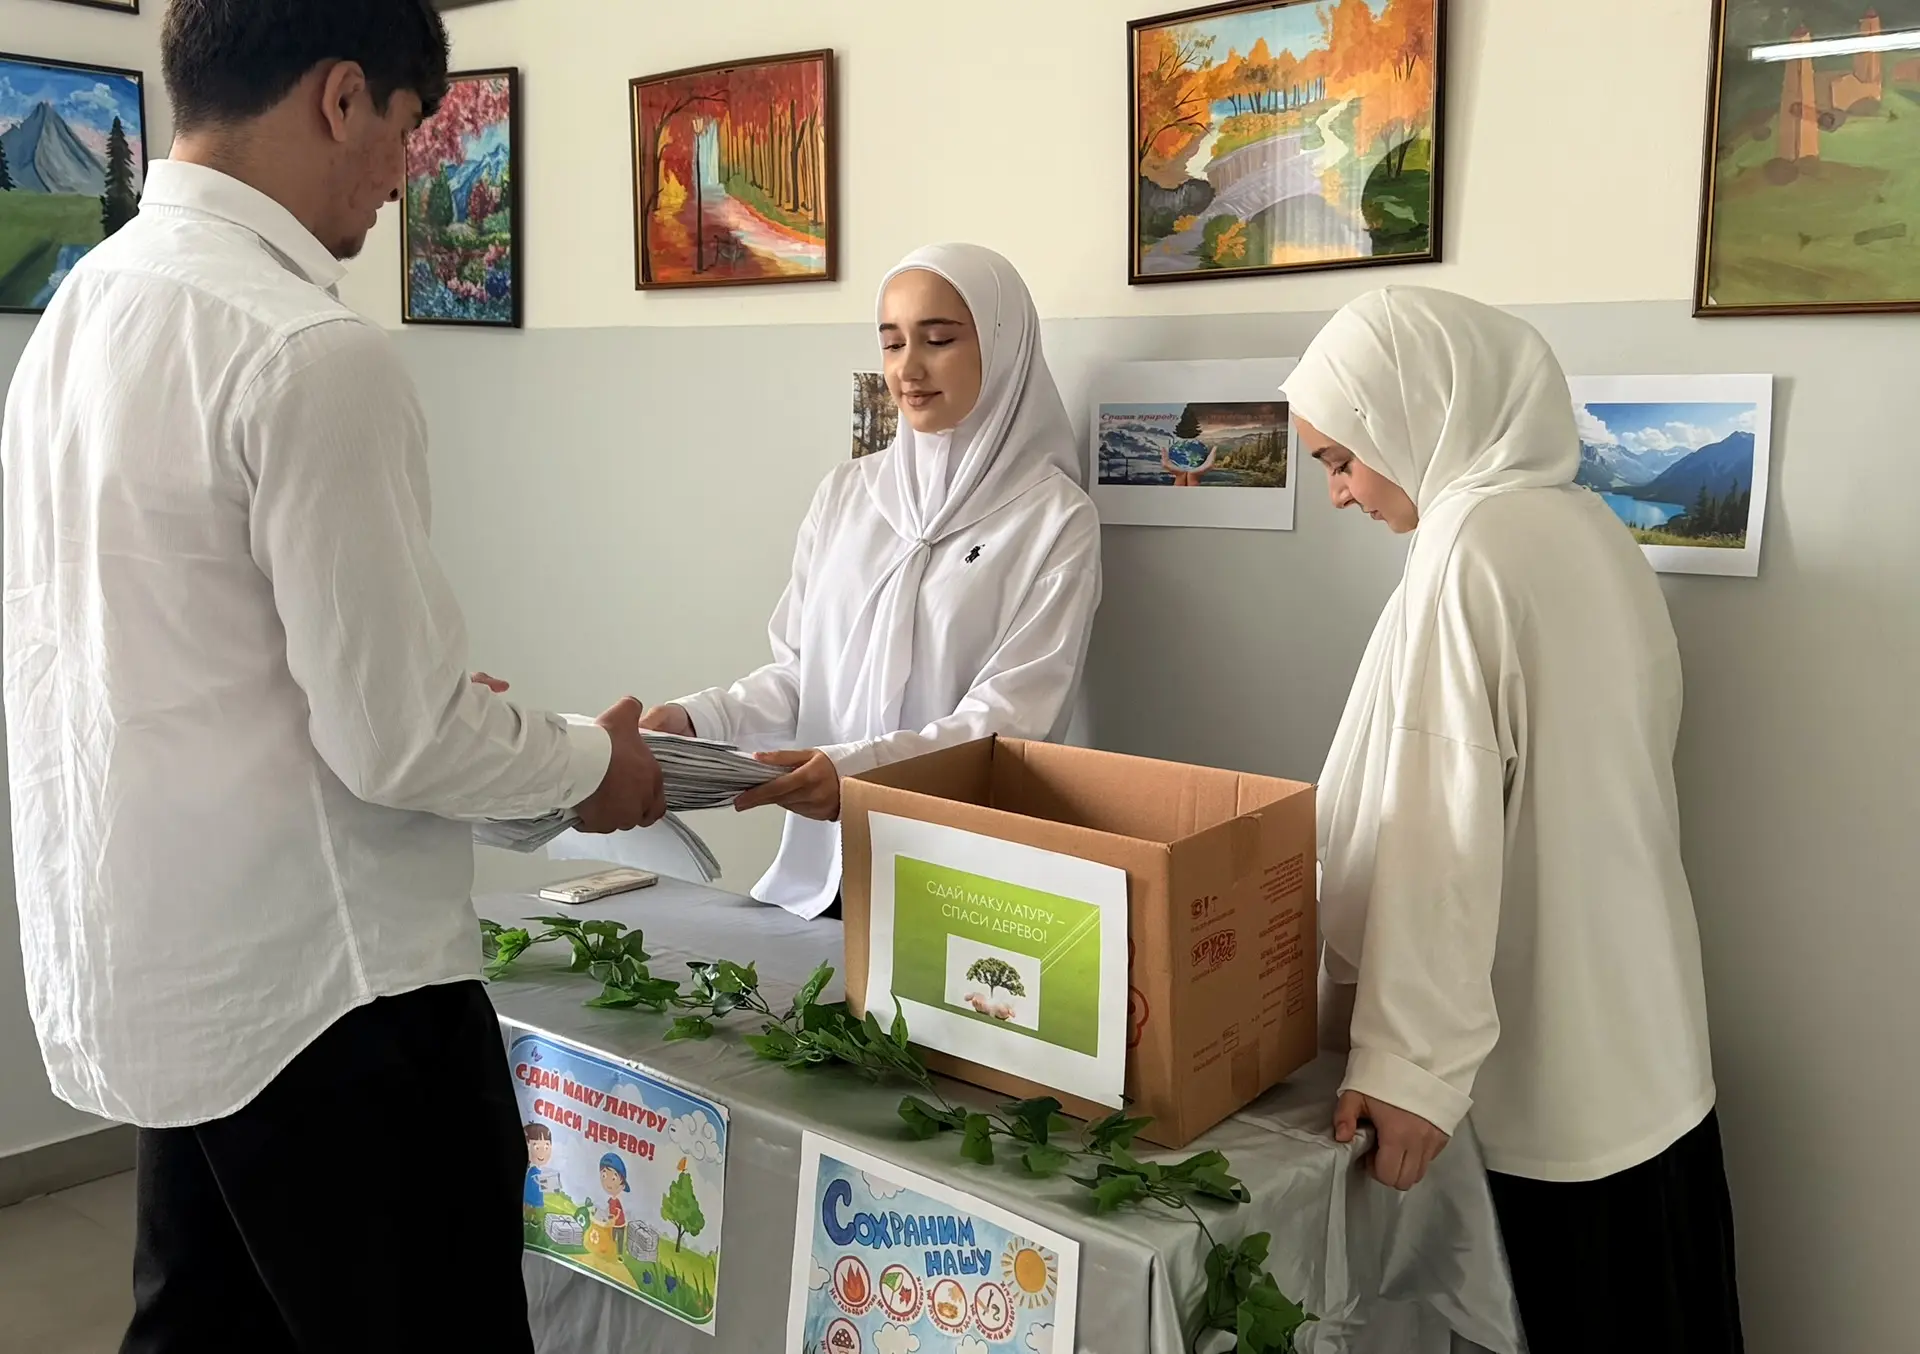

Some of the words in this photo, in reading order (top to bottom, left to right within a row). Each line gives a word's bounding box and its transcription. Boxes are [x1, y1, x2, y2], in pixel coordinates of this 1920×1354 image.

[926, 880, 964, 900] СДАЙ
[966, 892, 1054, 924] МАКУЛАТУРУ
[941, 903, 989, 928] СПАСИ
[992, 919, 1047, 943] ДЕРЕВО!
[515, 1063, 560, 1092] СДАЙ
[563, 1078, 667, 1133] МАКУЛАТУРУ
[534, 1098, 582, 1131] СПАСИ
[585, 1119, 655, 1160] ДЕРЕВО!
[925, 1248, 991, 1277] НАШУ
